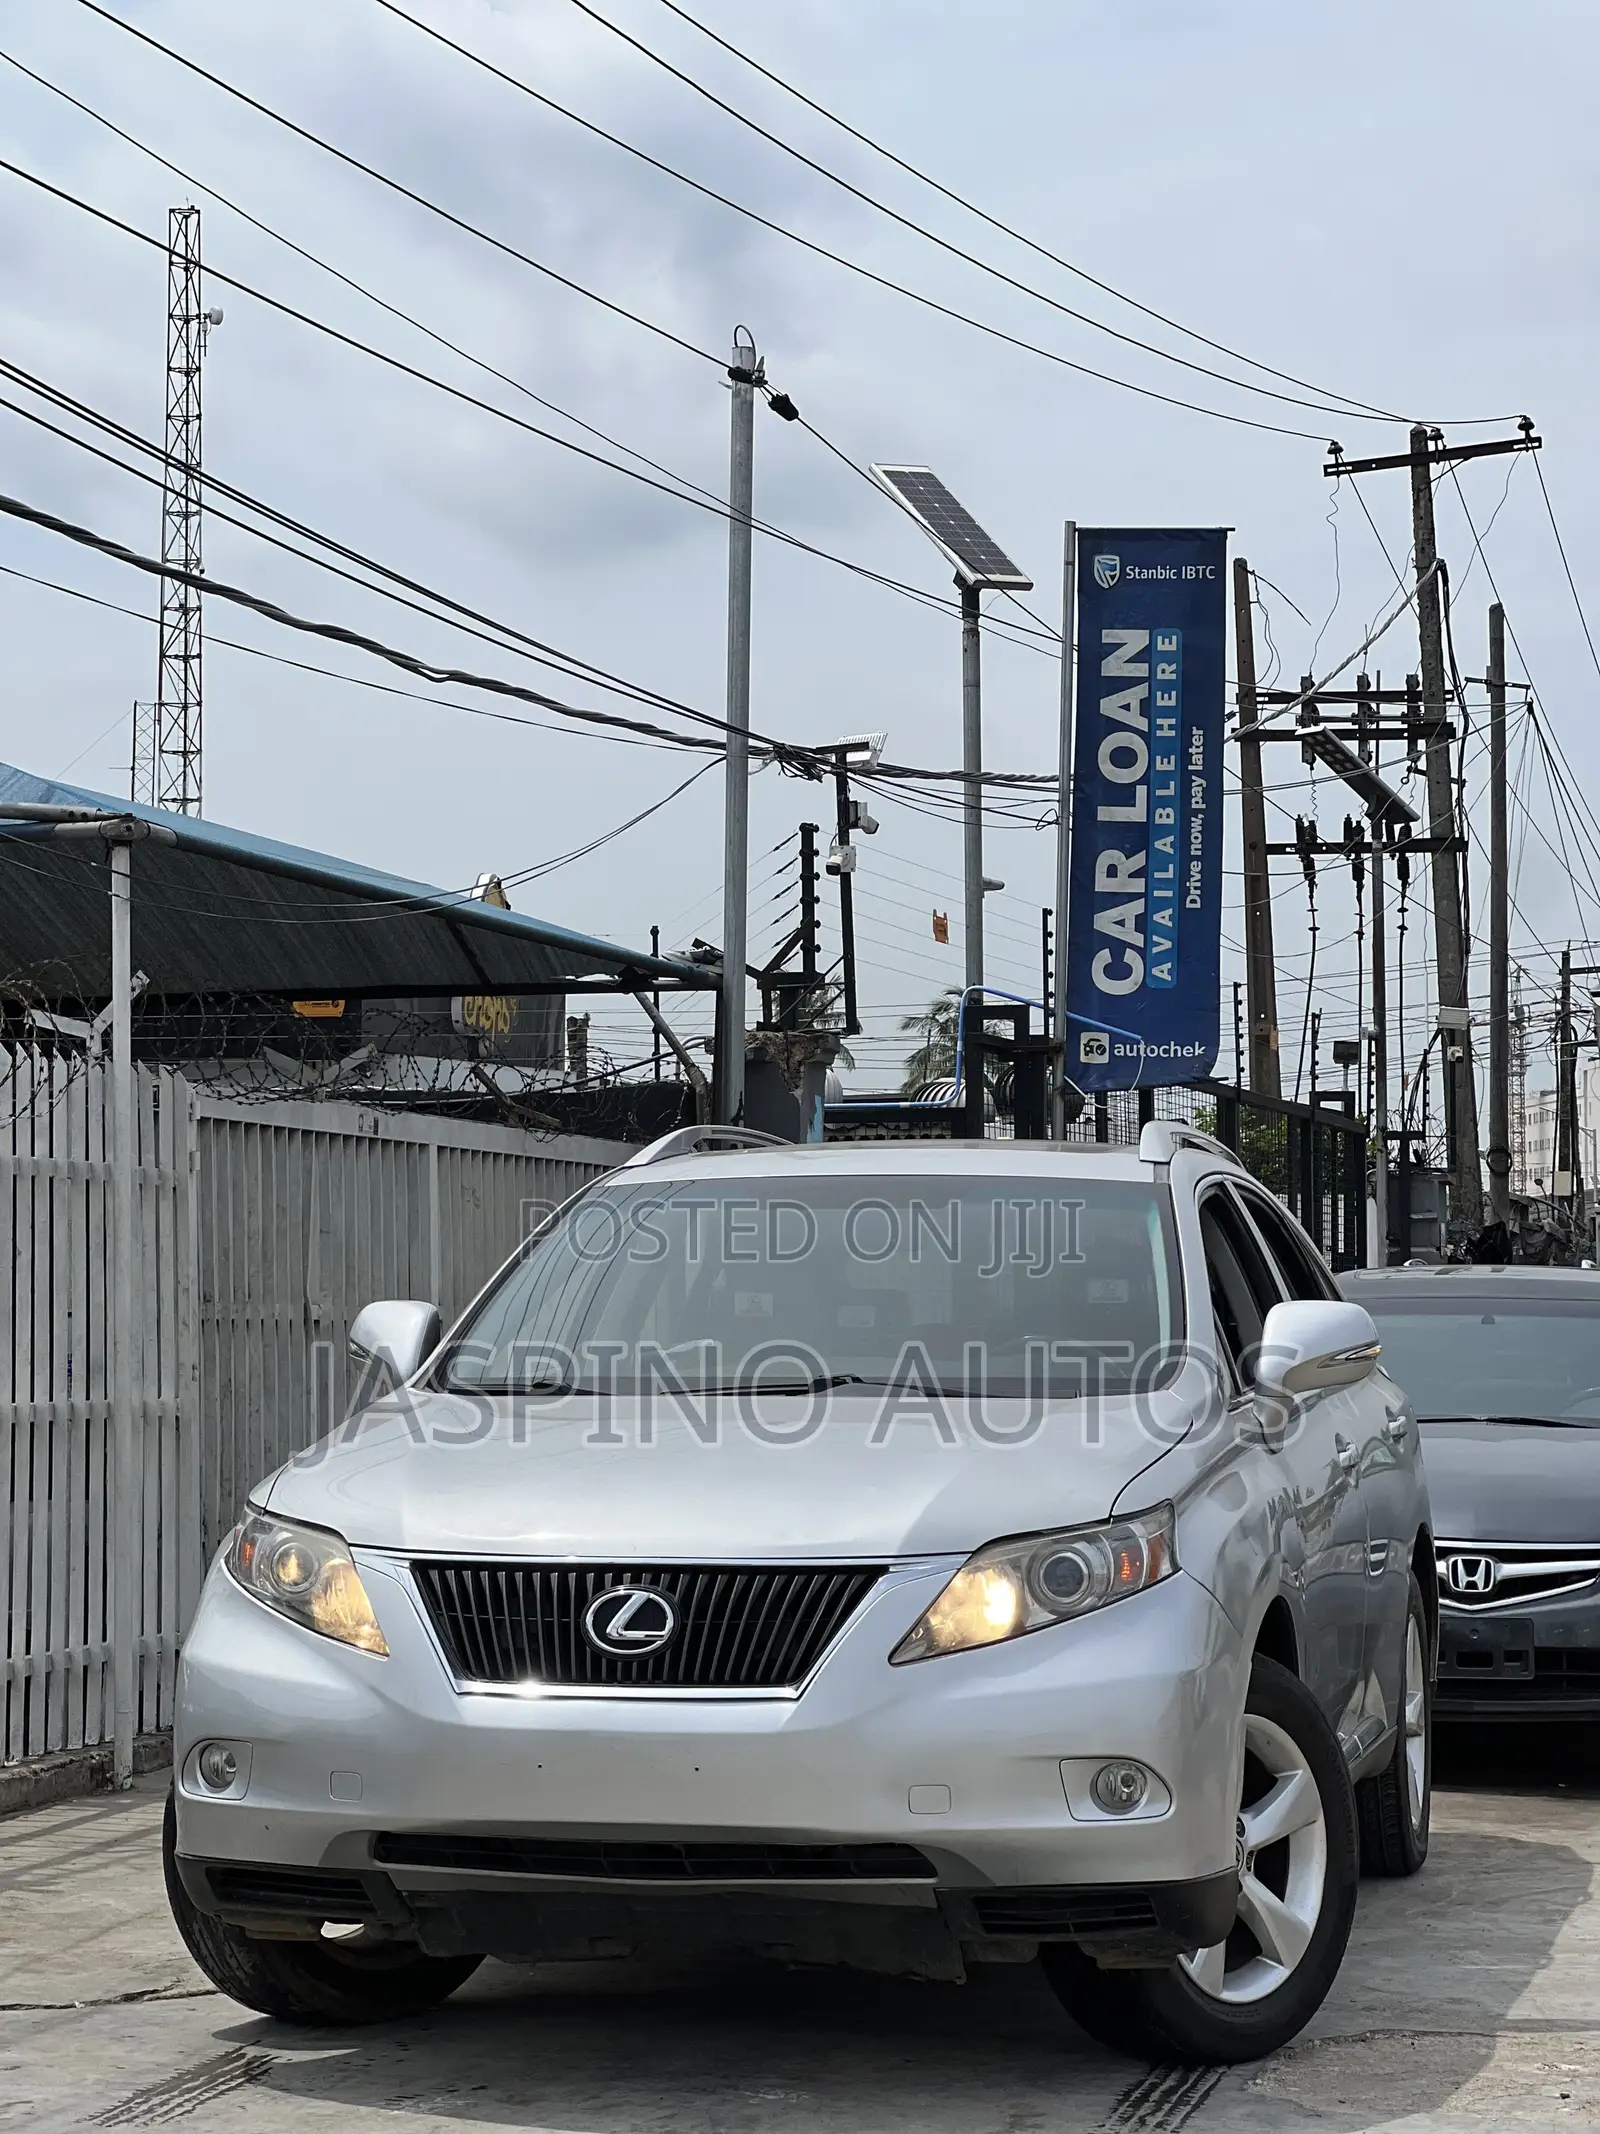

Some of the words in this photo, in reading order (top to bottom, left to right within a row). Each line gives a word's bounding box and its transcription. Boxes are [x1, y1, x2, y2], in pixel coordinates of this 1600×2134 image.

[1125, 565, 1178, 580] Stanbic
[1181, 565, 1216, 580] IBTC
[1156, 634, 1178, 736] HERE
[1097, 629, 1150, 822] LOAN
[1188, 726, 1204, 771] later
[1191, 774, 1207, 808] pay
[1190, 814, 1205, 855] now,
[1152, 754, 1176, 981] AVAILABLE
[1186, 860, 1202, 909] Drive
[1091, 849, 1147, 996] CAR
[1114, 1041, 1206, 1058] autochek
